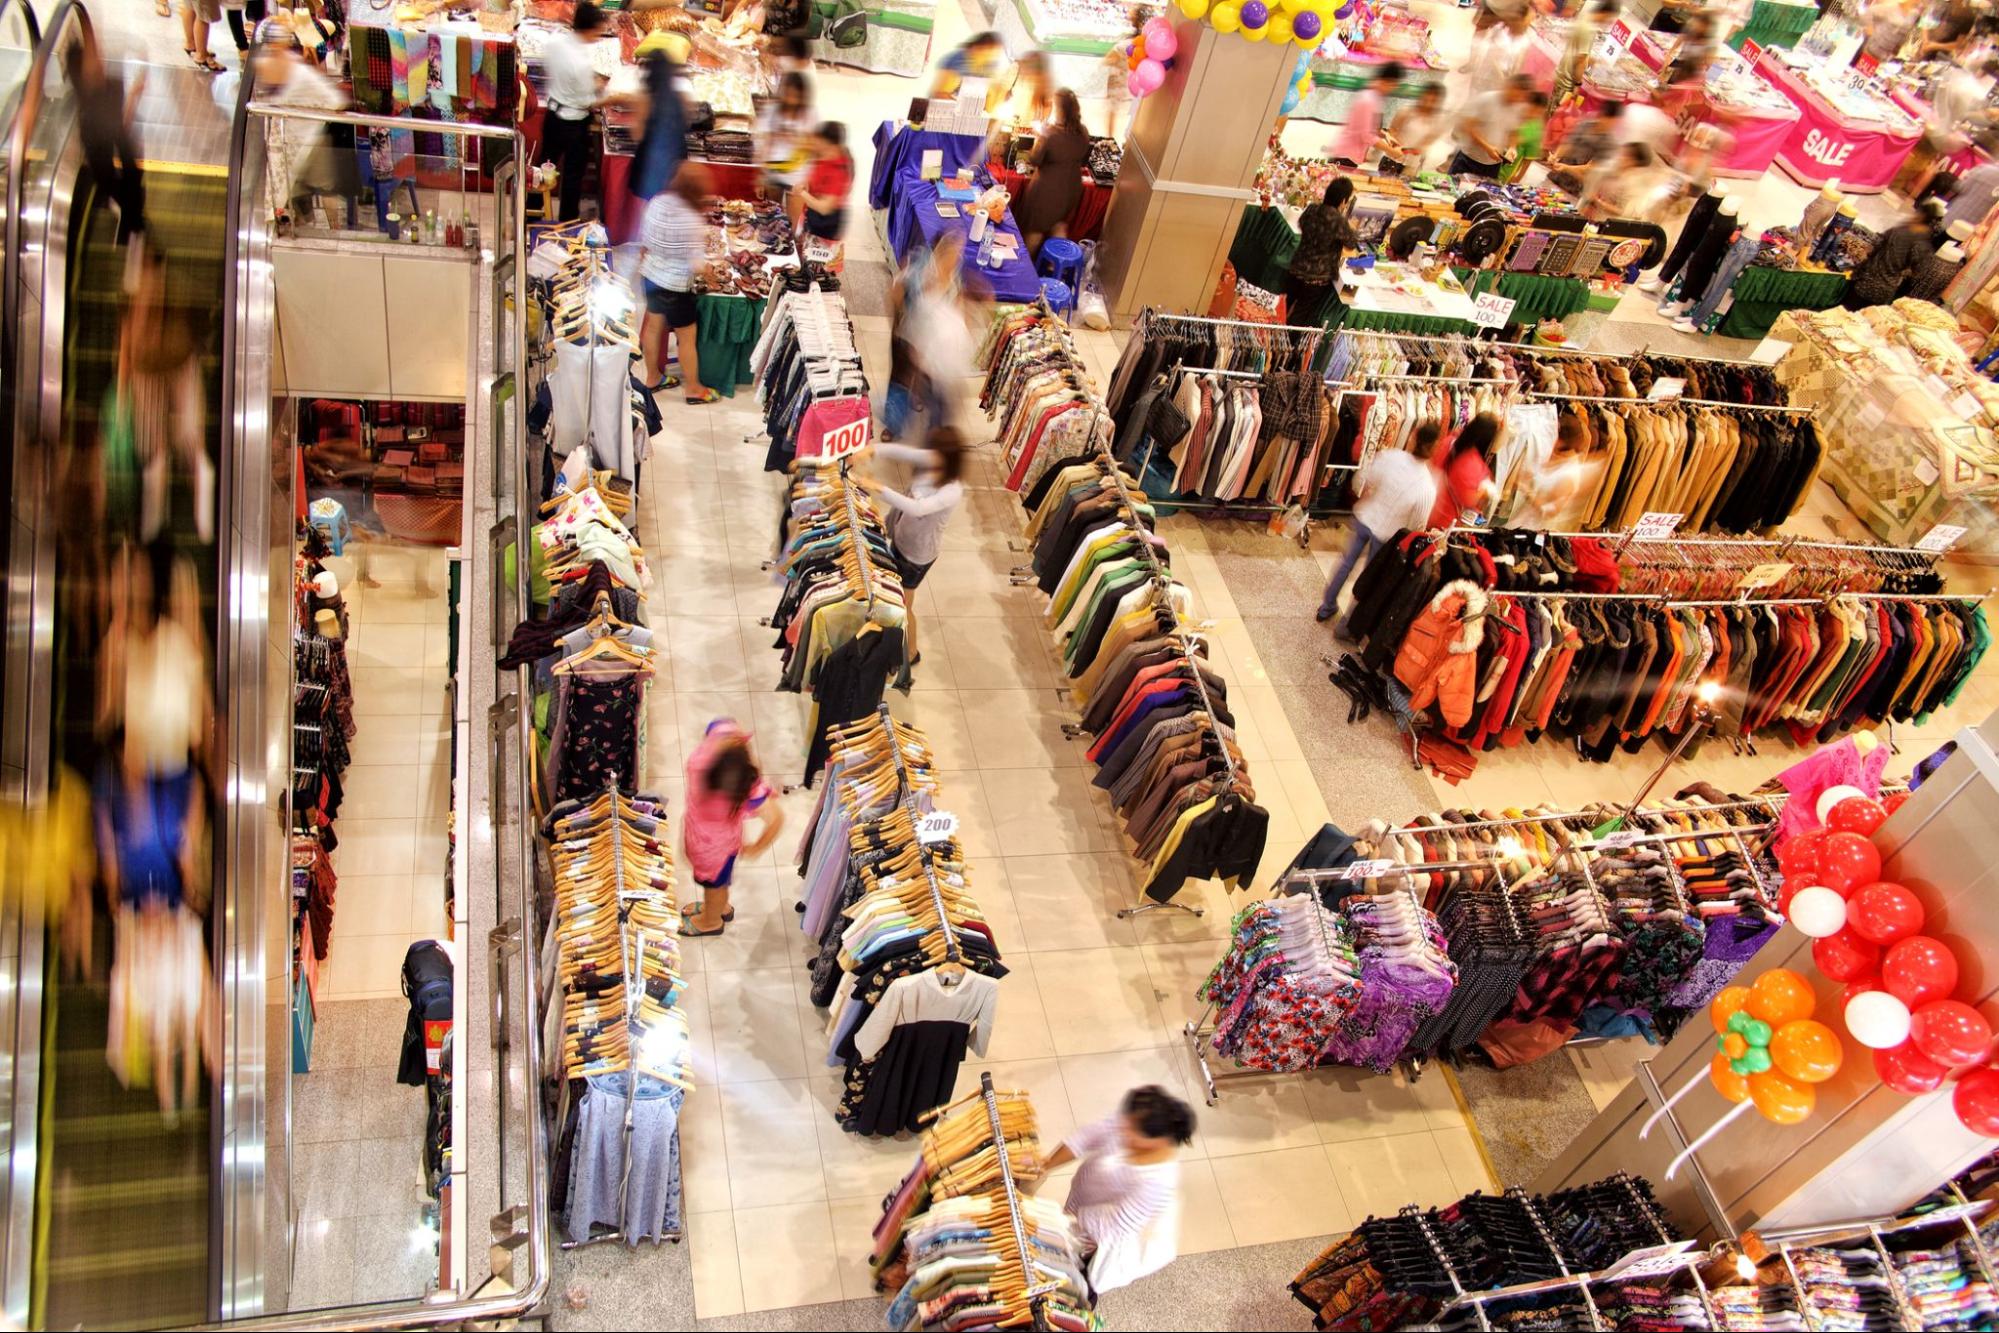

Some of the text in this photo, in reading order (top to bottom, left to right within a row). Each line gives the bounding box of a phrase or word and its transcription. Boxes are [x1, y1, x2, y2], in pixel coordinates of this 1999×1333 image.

[1611, 24, 1629, 45] SALE
[1741, 44, 1759, 64] SALE
[1857, 59, 1876, 77] SALE
[1848, 75, 1866, 90] 30
[1803, 128, 1856, 166] SALE
[1476, 296, 1513, 315] SALE
[826, 423, 865, 457] 100
[1640, 515, 1680, 526] SALE
[925, 818, 952, 831] 200
